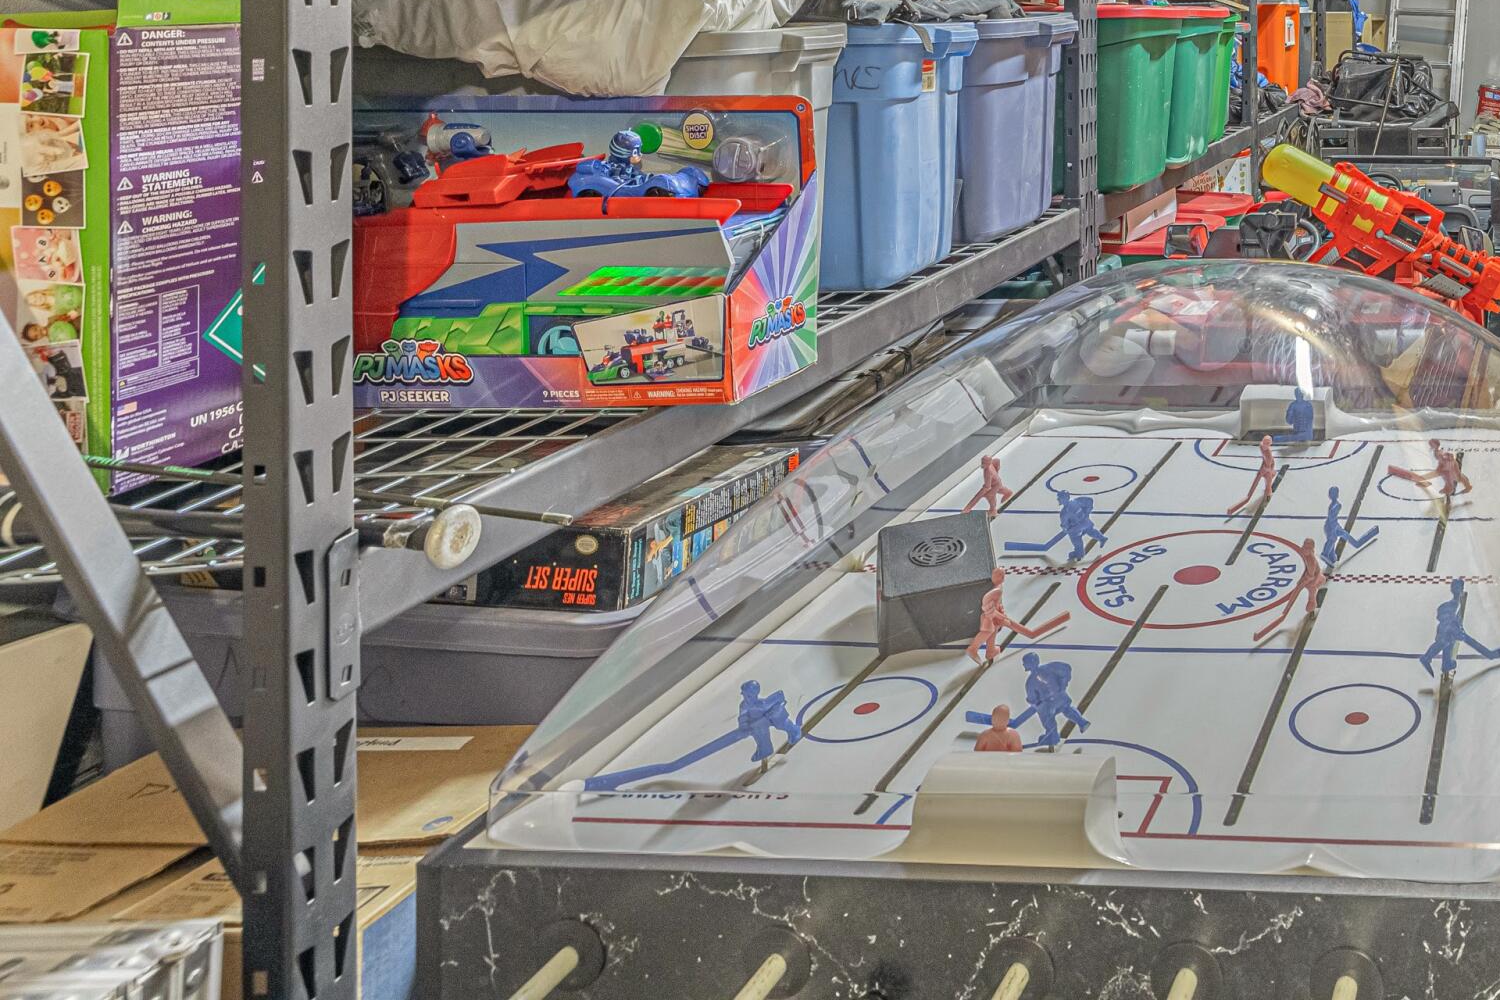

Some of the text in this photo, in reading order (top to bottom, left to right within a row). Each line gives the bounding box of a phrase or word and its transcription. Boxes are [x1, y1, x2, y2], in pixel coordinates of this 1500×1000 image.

[141, 29, 186, 40] DANGER:
[141, 39, 175, 47] CONTENTS
[685, 124, 709, 132] SHOOT
[141, 169, 190, 184] WARNING
[142, 176, 202, 193] STATEMENT:
[142, 210, 192, 226] WARNING:
[142, 219, 198, 234] CHOKING HAZARD
[381, 391, 449, 402] PJ SEEKER
[550, 390, 580, 398] PIECES
[190, 405, 236, 427] UN 1956
[524, 566, 598, 592] SUPER SET
[1094, 544, 1168, 609] SPORTS
[1216, 542, 1297, 616] CARROM
[562, 593, 597, 605] SUPER NES
